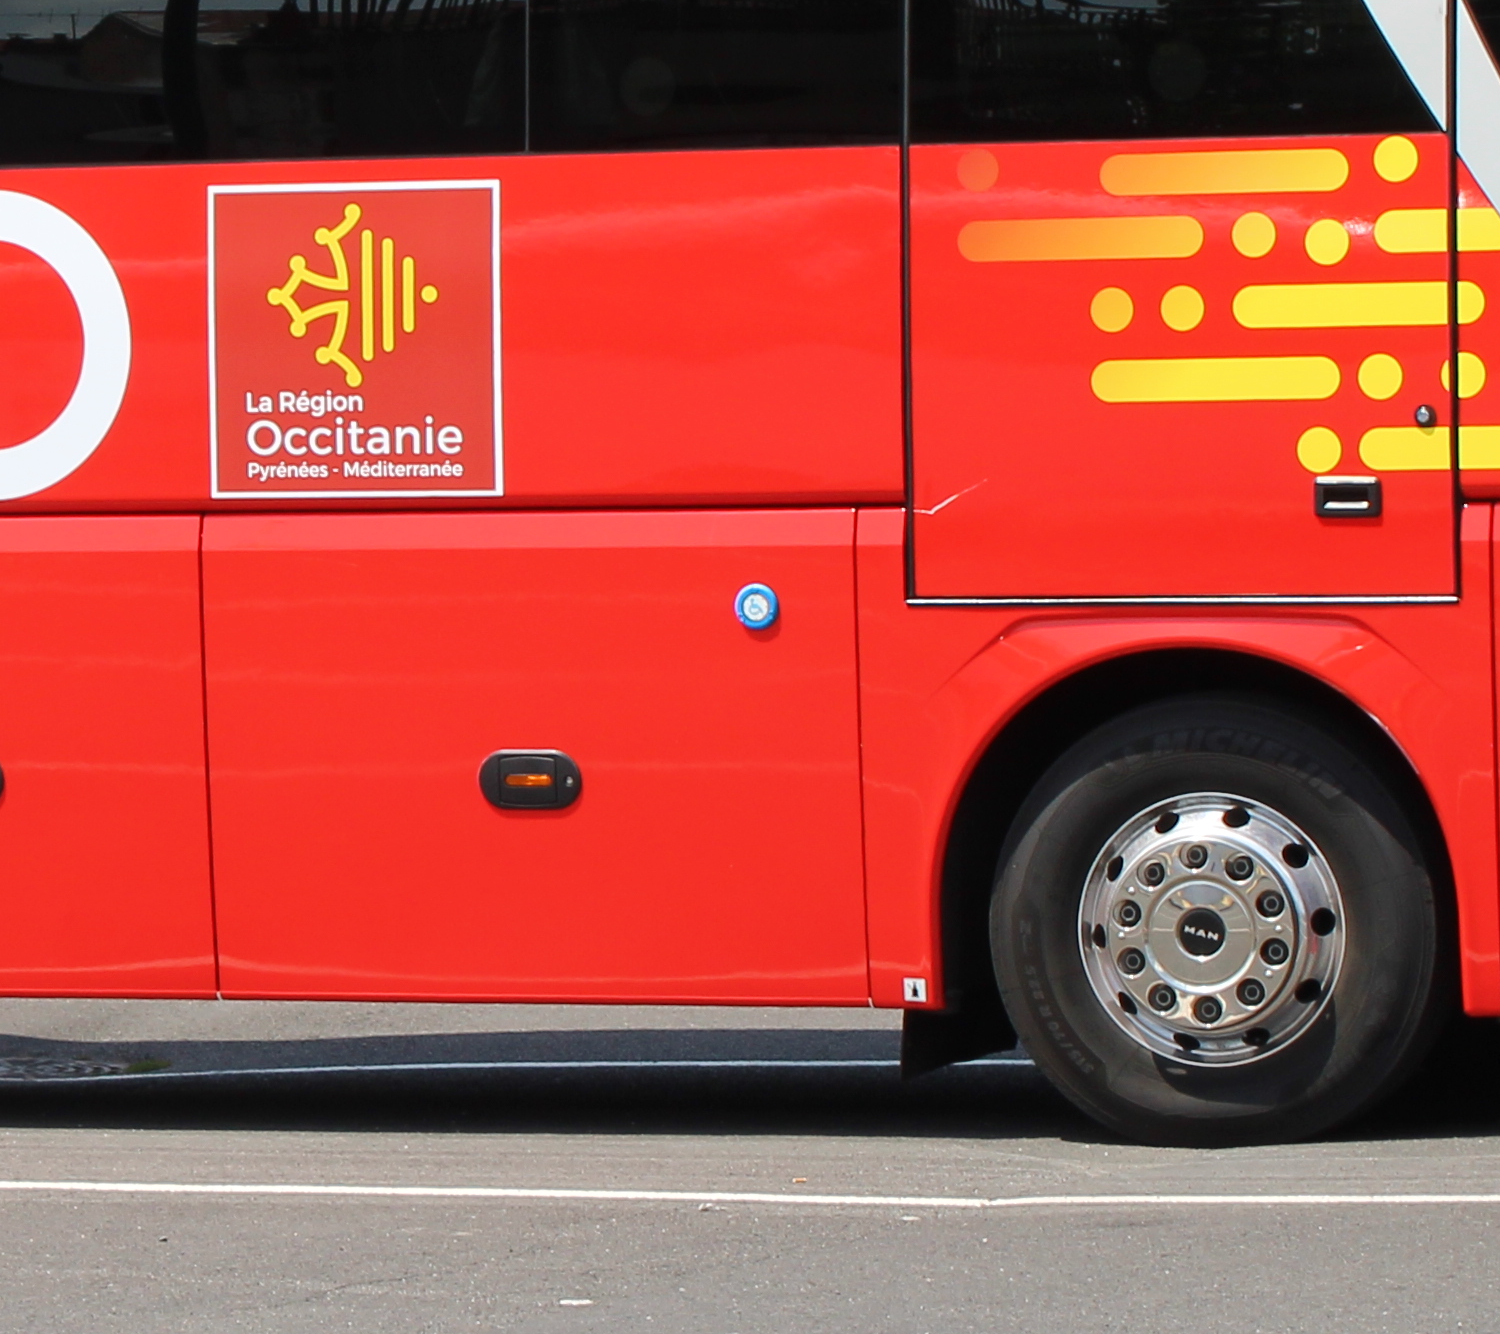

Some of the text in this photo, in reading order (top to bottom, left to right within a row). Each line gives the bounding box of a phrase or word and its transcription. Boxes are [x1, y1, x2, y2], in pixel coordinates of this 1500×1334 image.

[245, 389, 364, 418] La Région
[246, 415, 464, 457] Occitanie
[247, 460, 329, 482] Pyrénées
[343, 459, 464, 479] Méditerranée
[1183, 924, 1220, 942] MAN
